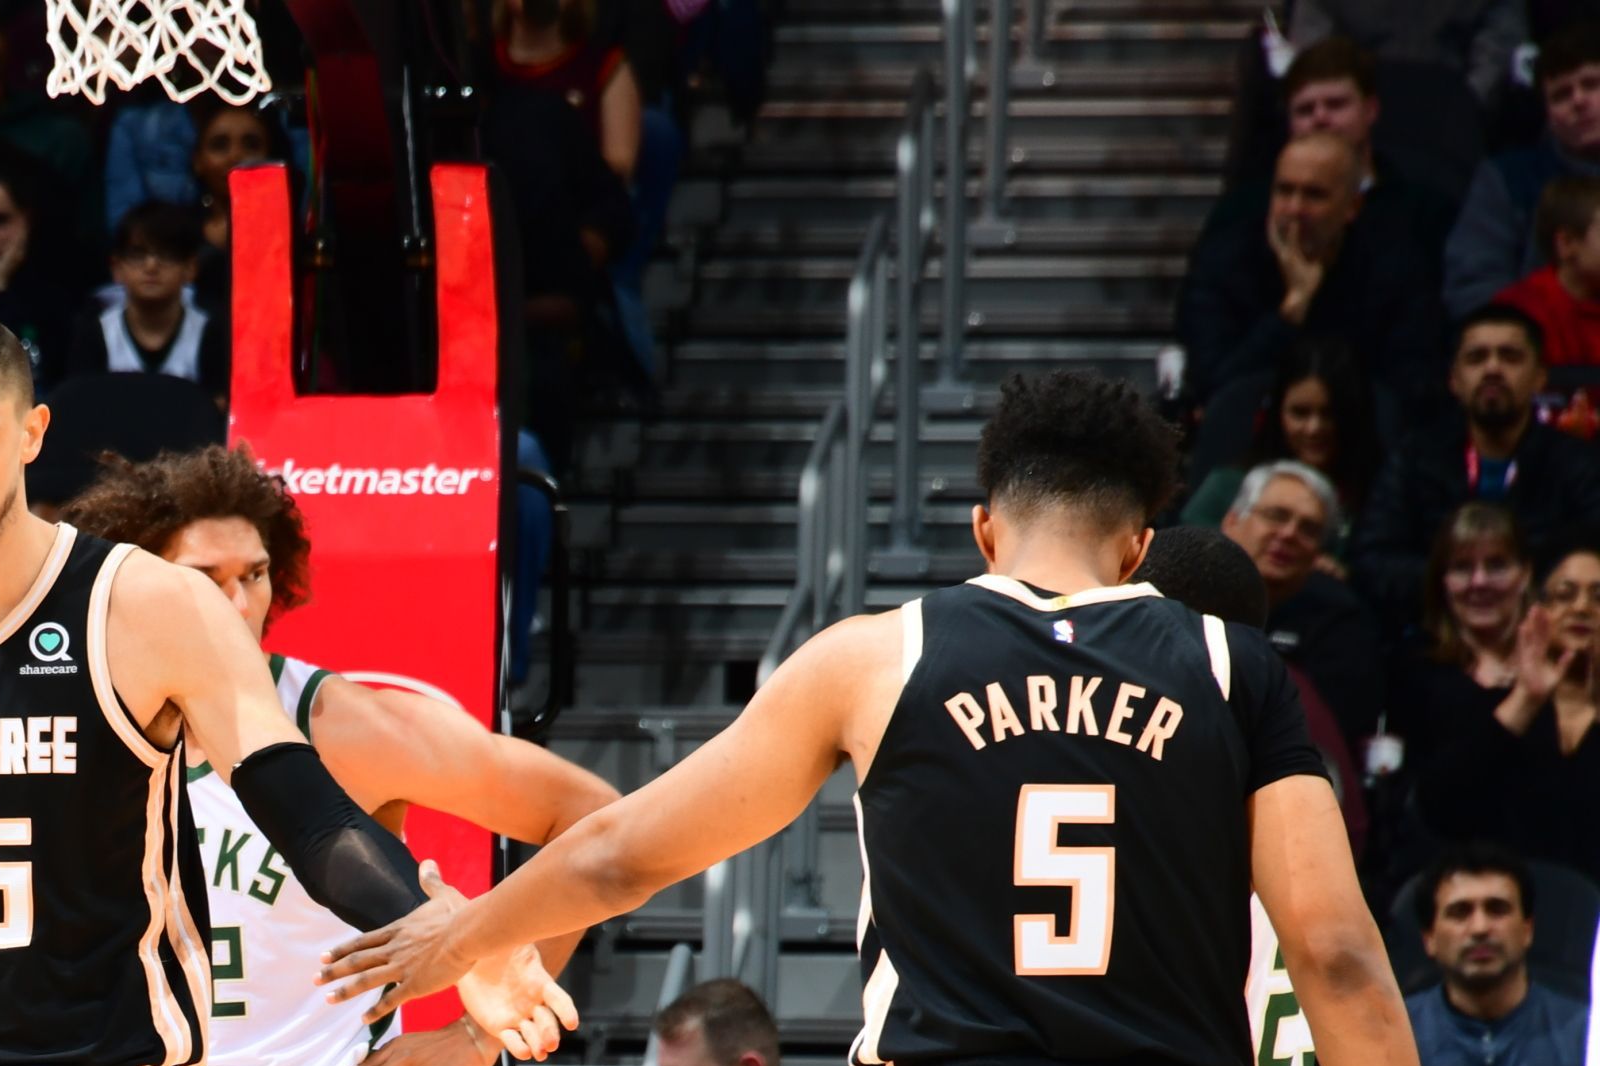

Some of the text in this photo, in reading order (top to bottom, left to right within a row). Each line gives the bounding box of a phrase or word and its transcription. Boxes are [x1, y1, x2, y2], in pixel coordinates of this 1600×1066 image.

[256, 459, 477, 496] ketmaster
[19, 664, 78, 675] sharecare
[944, 675, 1184, 761] PARKER
[196, 827, 291, 906] KS
[1013, 783, 1117, 976] 5
